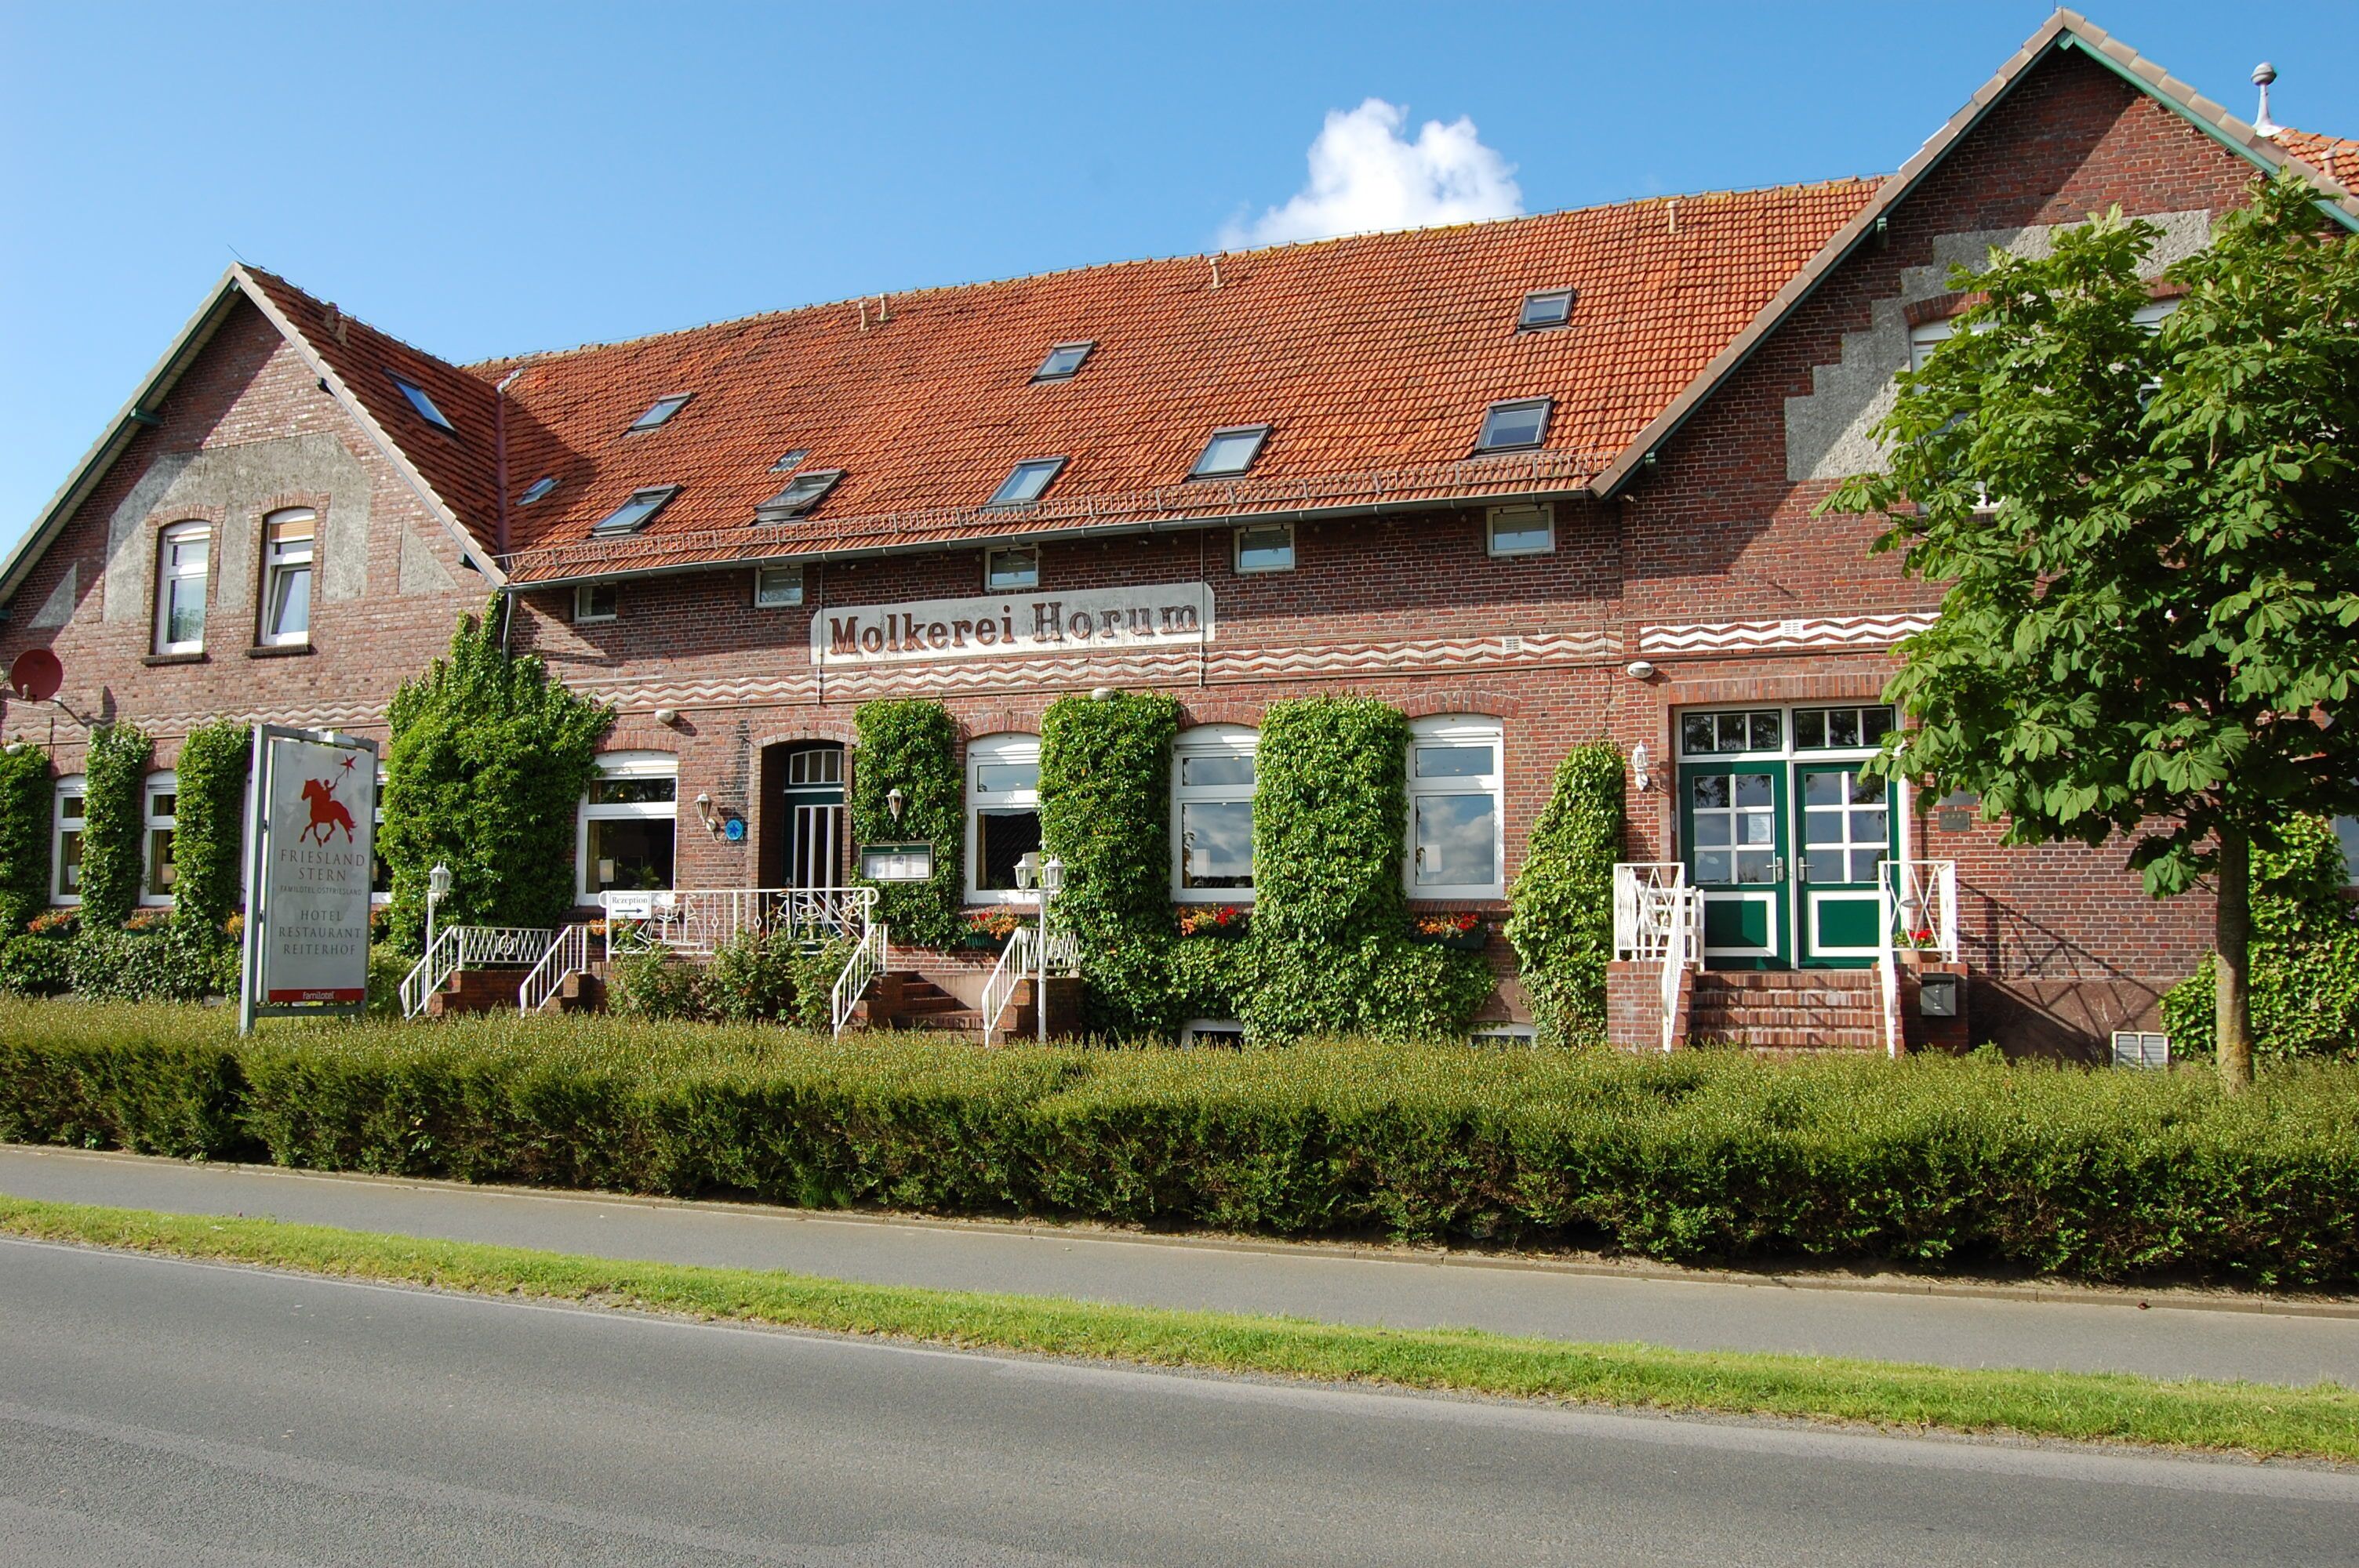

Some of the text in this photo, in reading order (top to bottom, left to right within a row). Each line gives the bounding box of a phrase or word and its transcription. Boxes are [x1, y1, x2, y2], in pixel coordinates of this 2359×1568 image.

[830, 601, 1200, 655] Molkerei Horum
[281, 849, 365, 866] FRIESLAND
[299, 867, 346, 881] STERN
[317, 887, 362, 895] OSTFRIESLAND
[612, 896, 648, 906] Rezeption
[300, 910, 343, 921] HOTEL
[278, 927, 362, 938] RESTAURANT
[283, 944, 356, 955] REITERHOF
[303, 991, 335, 1000] familotel
